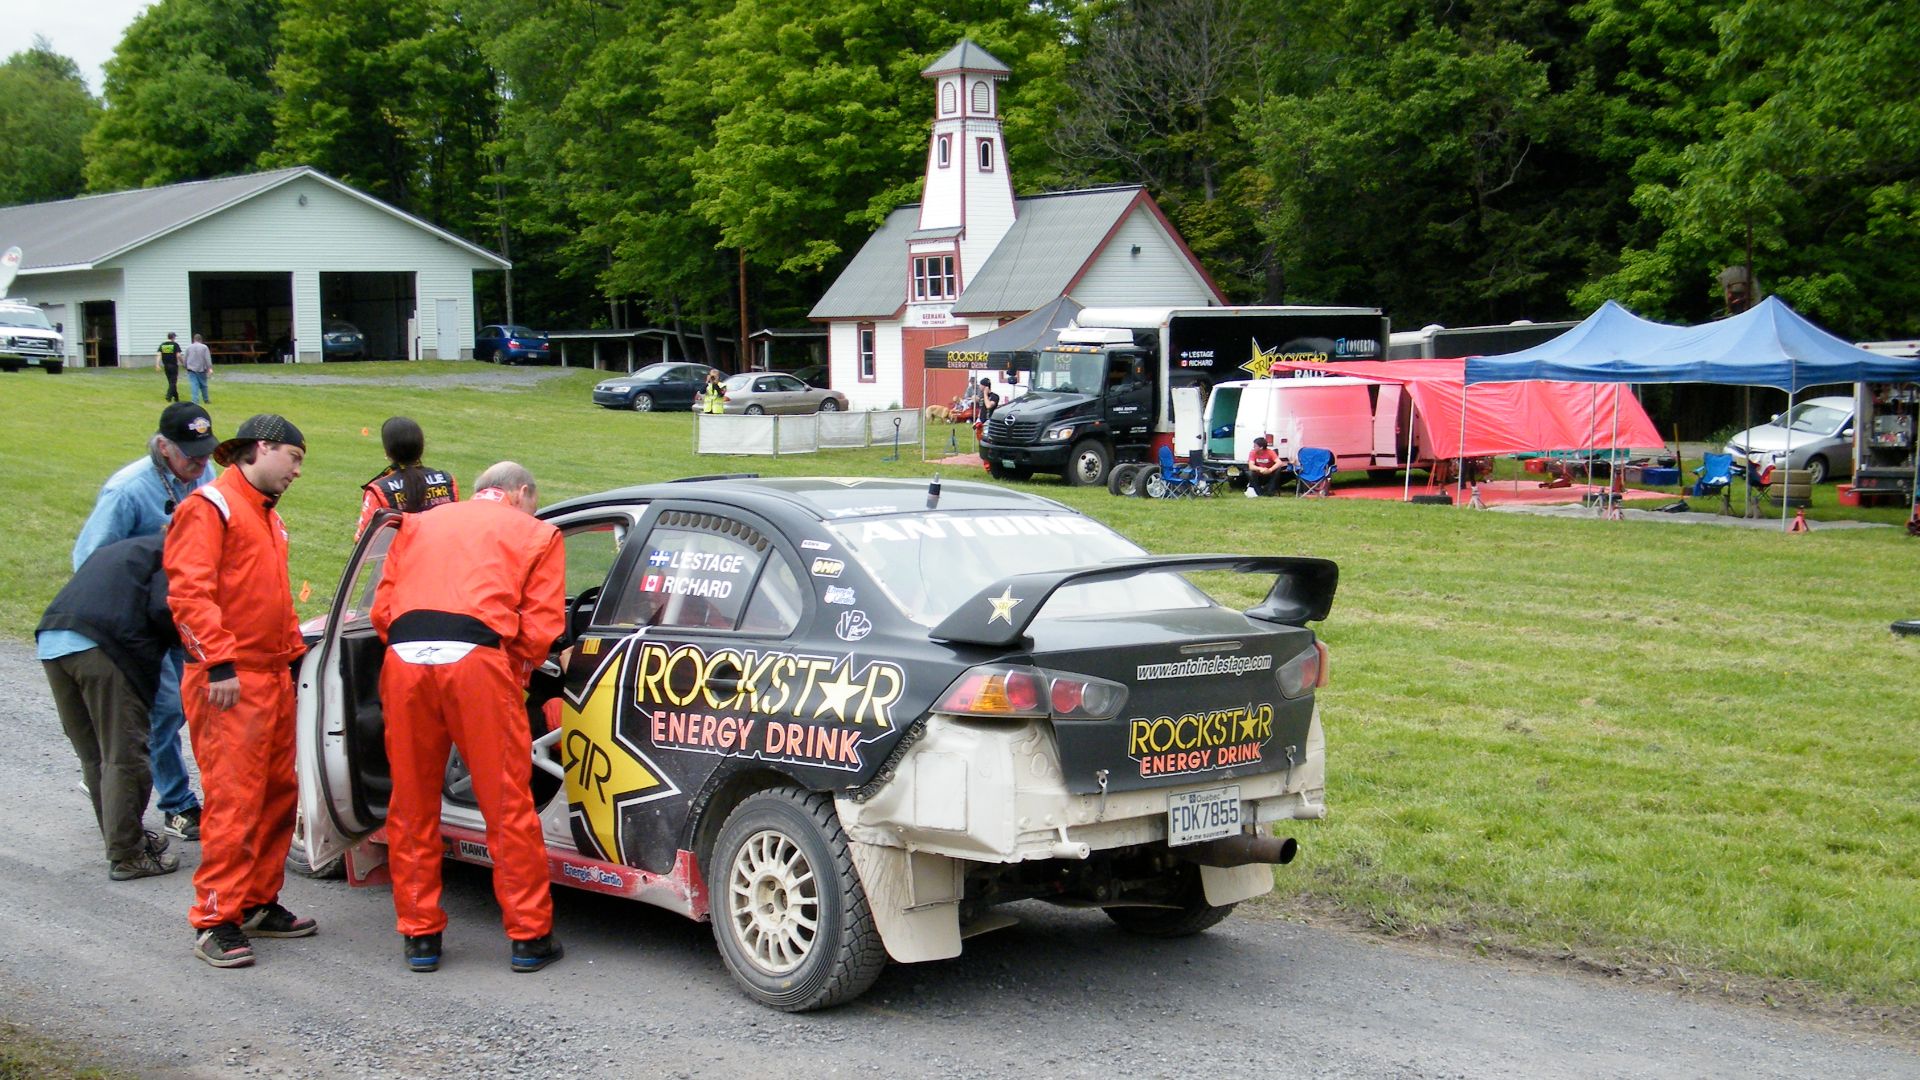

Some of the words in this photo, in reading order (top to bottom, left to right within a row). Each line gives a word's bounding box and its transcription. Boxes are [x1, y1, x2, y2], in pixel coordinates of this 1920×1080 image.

[948, 350, 989, 362] ROCKSTAR
[860, 514, 1101, 544] ANTOINE
[670, 551, 744, 574] L'ESTAGE
[662, 575, 732, 598] RICHARD
[840, 610, 866, 639] VP
[1137, 654, 1272, 680] www.antoinelestage.com
[638, 645, 901, 728] ROCKSTAR
[652, 710, 754, 751] ENERGY
[766, 721, 862, 764] DRINK
[1130, 704, 1274, 755] ROCKSTAR
[1141, 750, 1211, 775] ENERGY
[1218, 742, 1262, 766] DRINK
[1172, 798, 1239, 834] FDK7855
[461, 842, 490, 858] HAWK
[599, 870, 623, 888] Cardio
